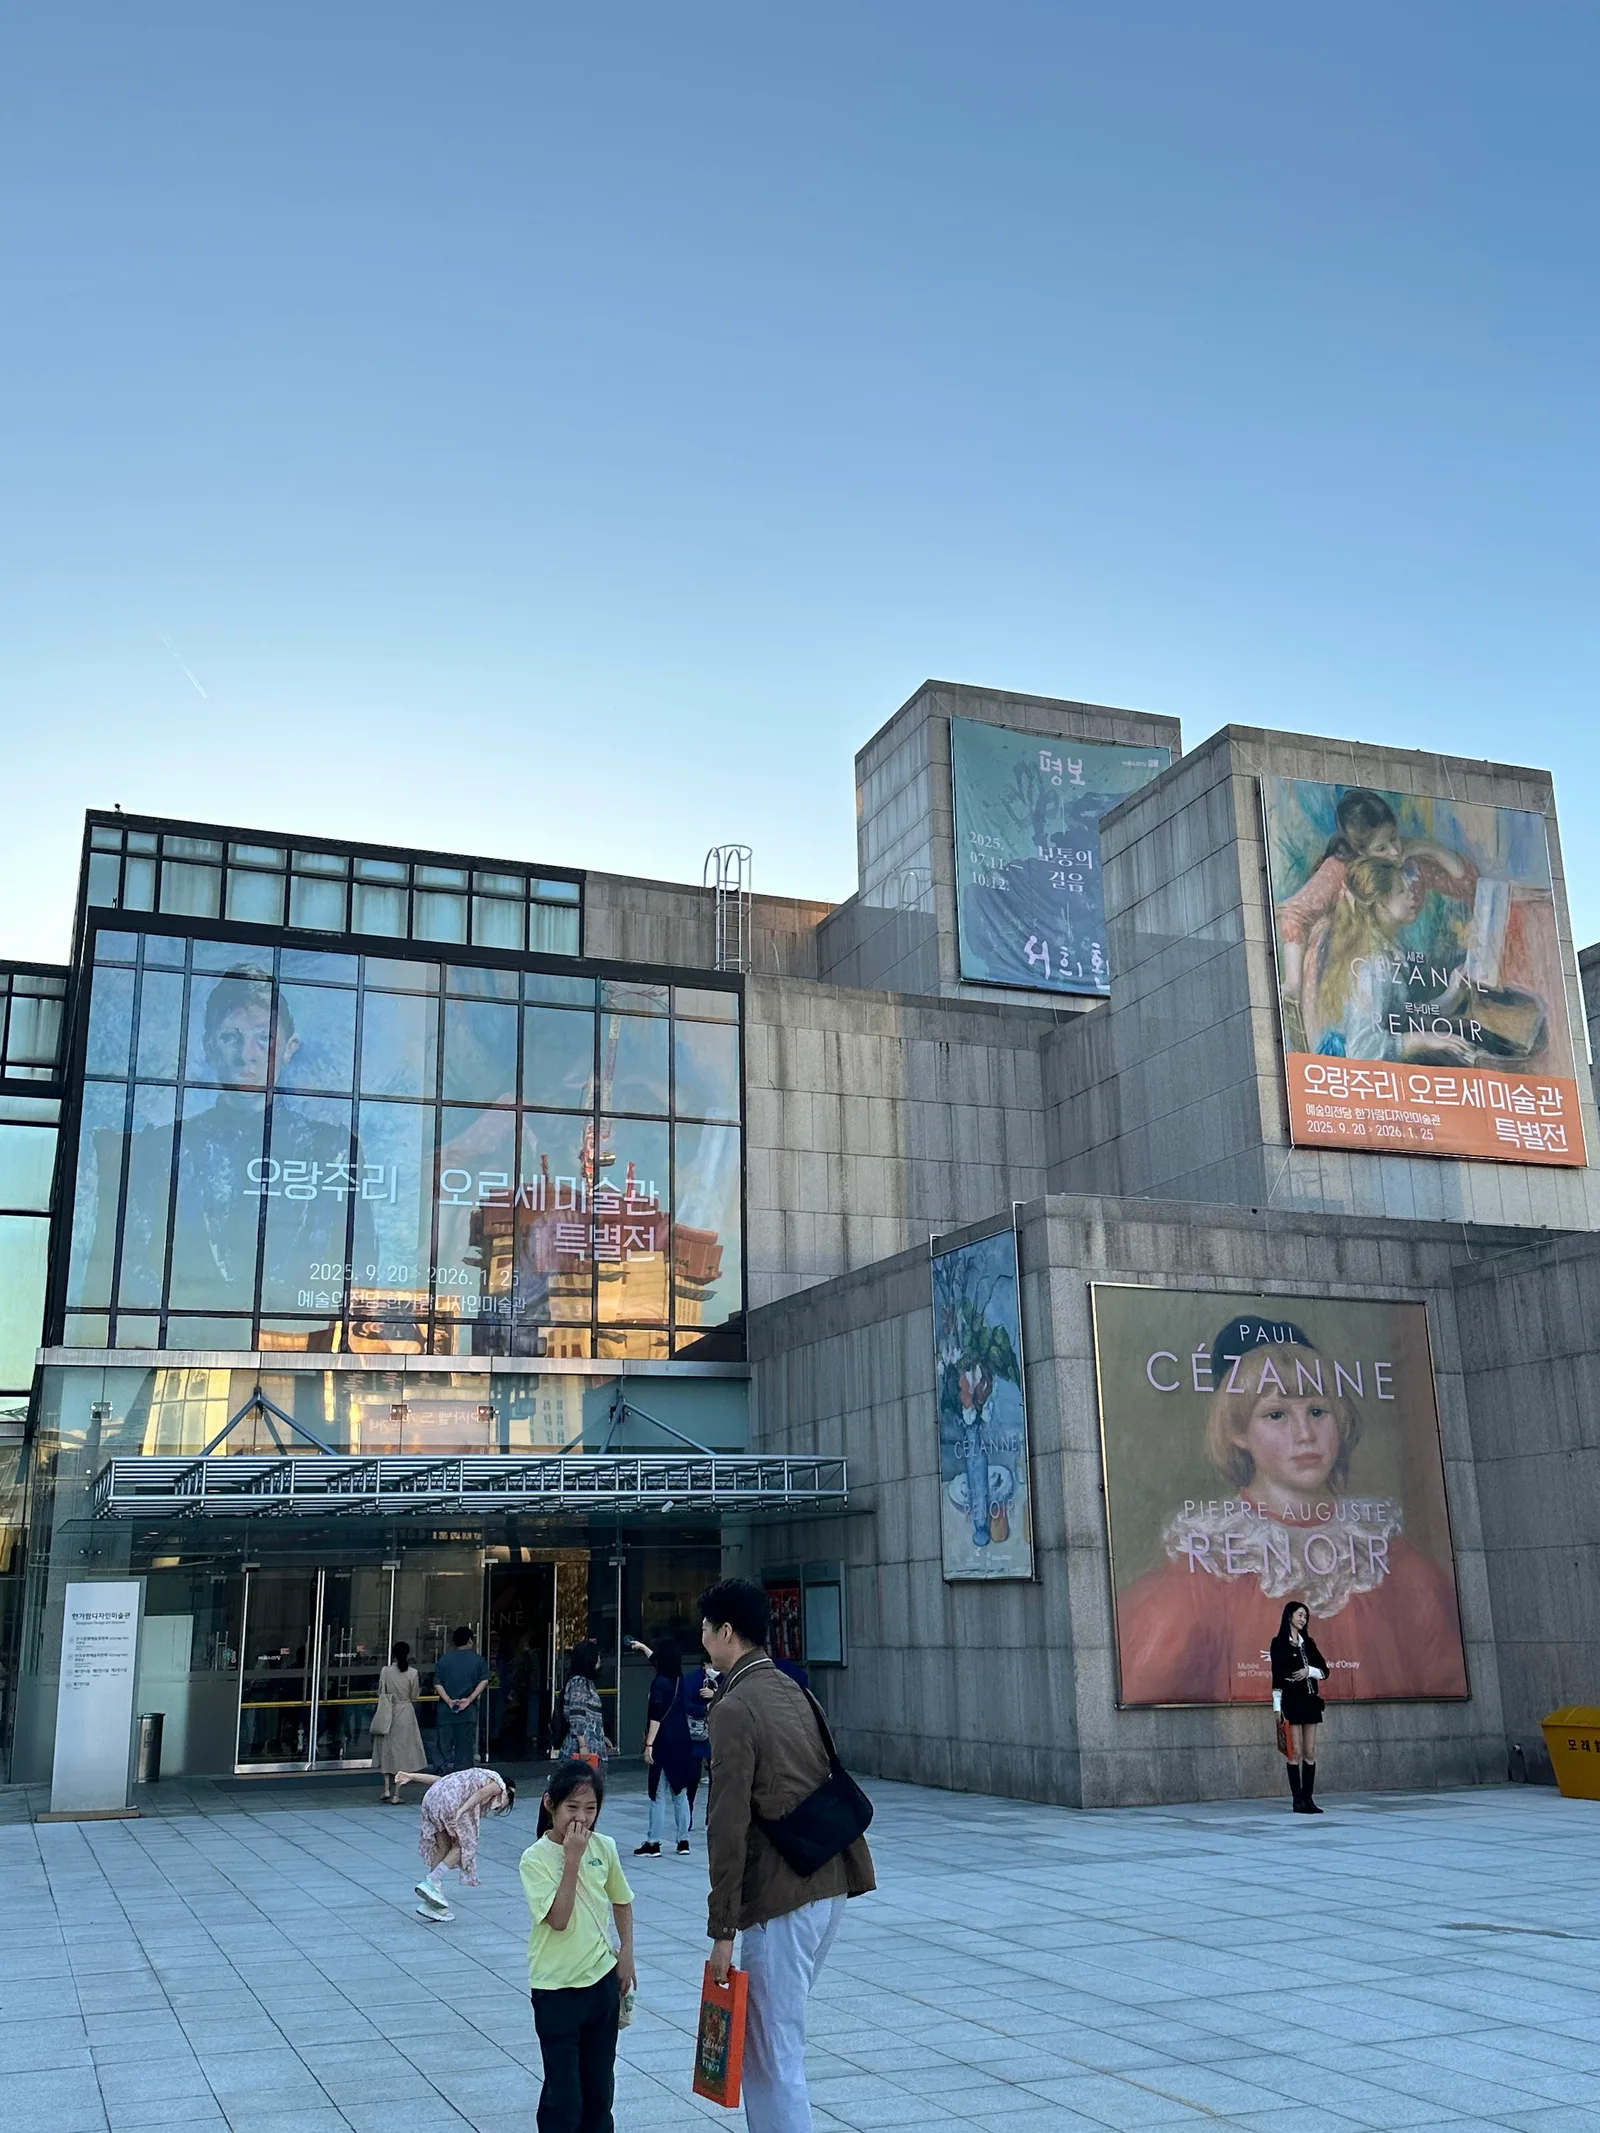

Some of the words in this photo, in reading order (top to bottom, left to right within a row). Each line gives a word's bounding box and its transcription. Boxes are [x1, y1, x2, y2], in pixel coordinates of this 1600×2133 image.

[1039, 750, 1085, 786] 평보
[970, 831, 1005, 850] 2025.
[1038, 846, 1093, 870] 보통의
[972, 872, 1010, 892] 10.12.
[1049, 870, 1085, 893] 걸음
[1407, 951, 1425, 964] 세잔
[1405, 1002, 1441, 1016] 르누아르
[1371, 1012, 1483, 1042] RENOIR
[1304, 1064, 1399, 1101] 오랑주리
[1408, 1075, 1564, 1117] 오르세미술관
[1305, 1103, 1352, 1120] 예술의전당
[1355, 1108, 1442, 1126] 한가람디자인미술관
[1352, 1123, 1366, 1136] 20
[1420, 1128, 1434, 1141] 25
[1496, 1117, 1569, 1152] 특별전
[243, 1158, 397, 1204] 오랑주리
[439, 1168, 659, 1217] 오르세미술관
[553, 1222, 656, 1263] 특별전
[387, 1265, 408, 1283] 20
[500, 1270, 520, 1288] 25
[297, 1289, 383, 1310] 예술의전당
[1239, 1324, 1298, 1345] PAUL
[1146, 1342, 1395, 1400] CÉZANNE
[954, 1432, 1018, 1459] CÉZANNE
[1184, 1499, 1269, 1521] PIERRE
[1281, 1501, 1388, 1522] AUGUSTE
[1186, 1531, 1391, 1576] RENOIR
